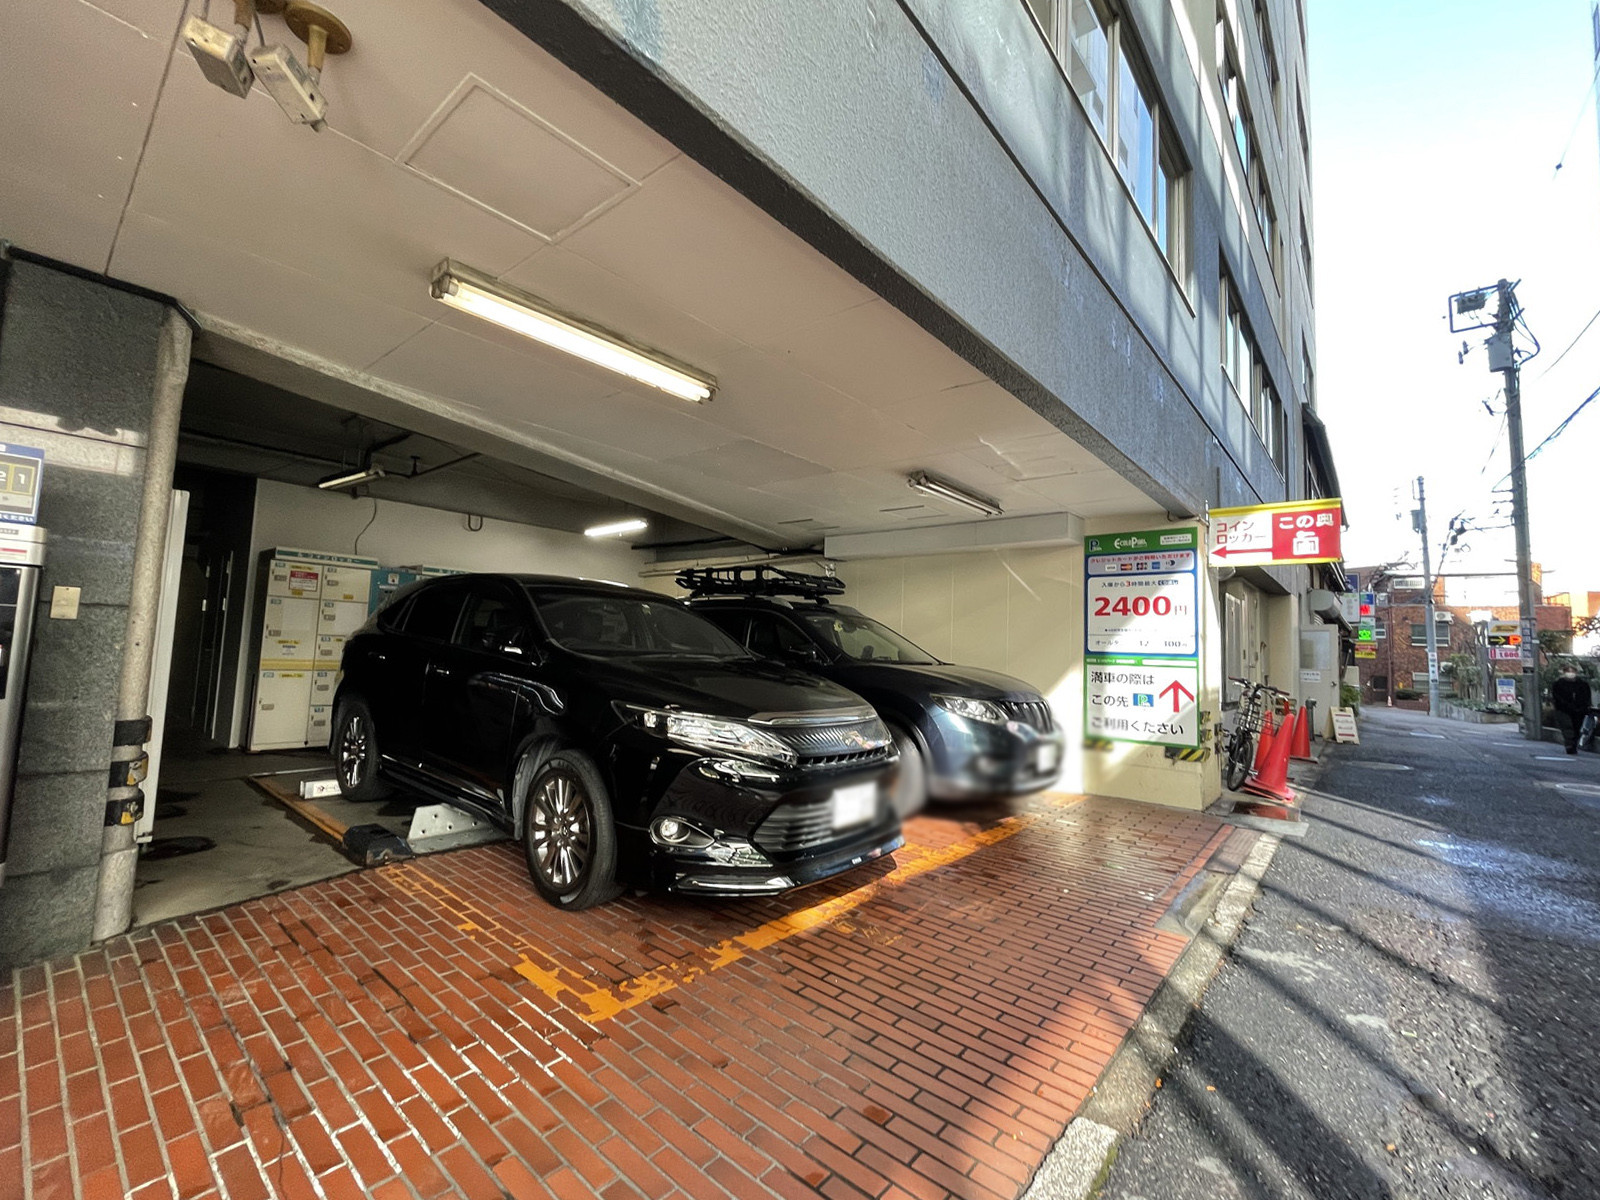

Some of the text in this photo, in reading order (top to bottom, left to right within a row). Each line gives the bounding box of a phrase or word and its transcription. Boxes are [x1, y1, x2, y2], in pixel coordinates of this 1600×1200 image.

[1217, 520, 1254, 533] コイン
[1279, 513, 1334, 530] この奥
[1217, 533, 1266, 545] ロッカー
[1091, 671, 1155, 686] 満車の際は
[1091, 694, 1129, 708] この先
